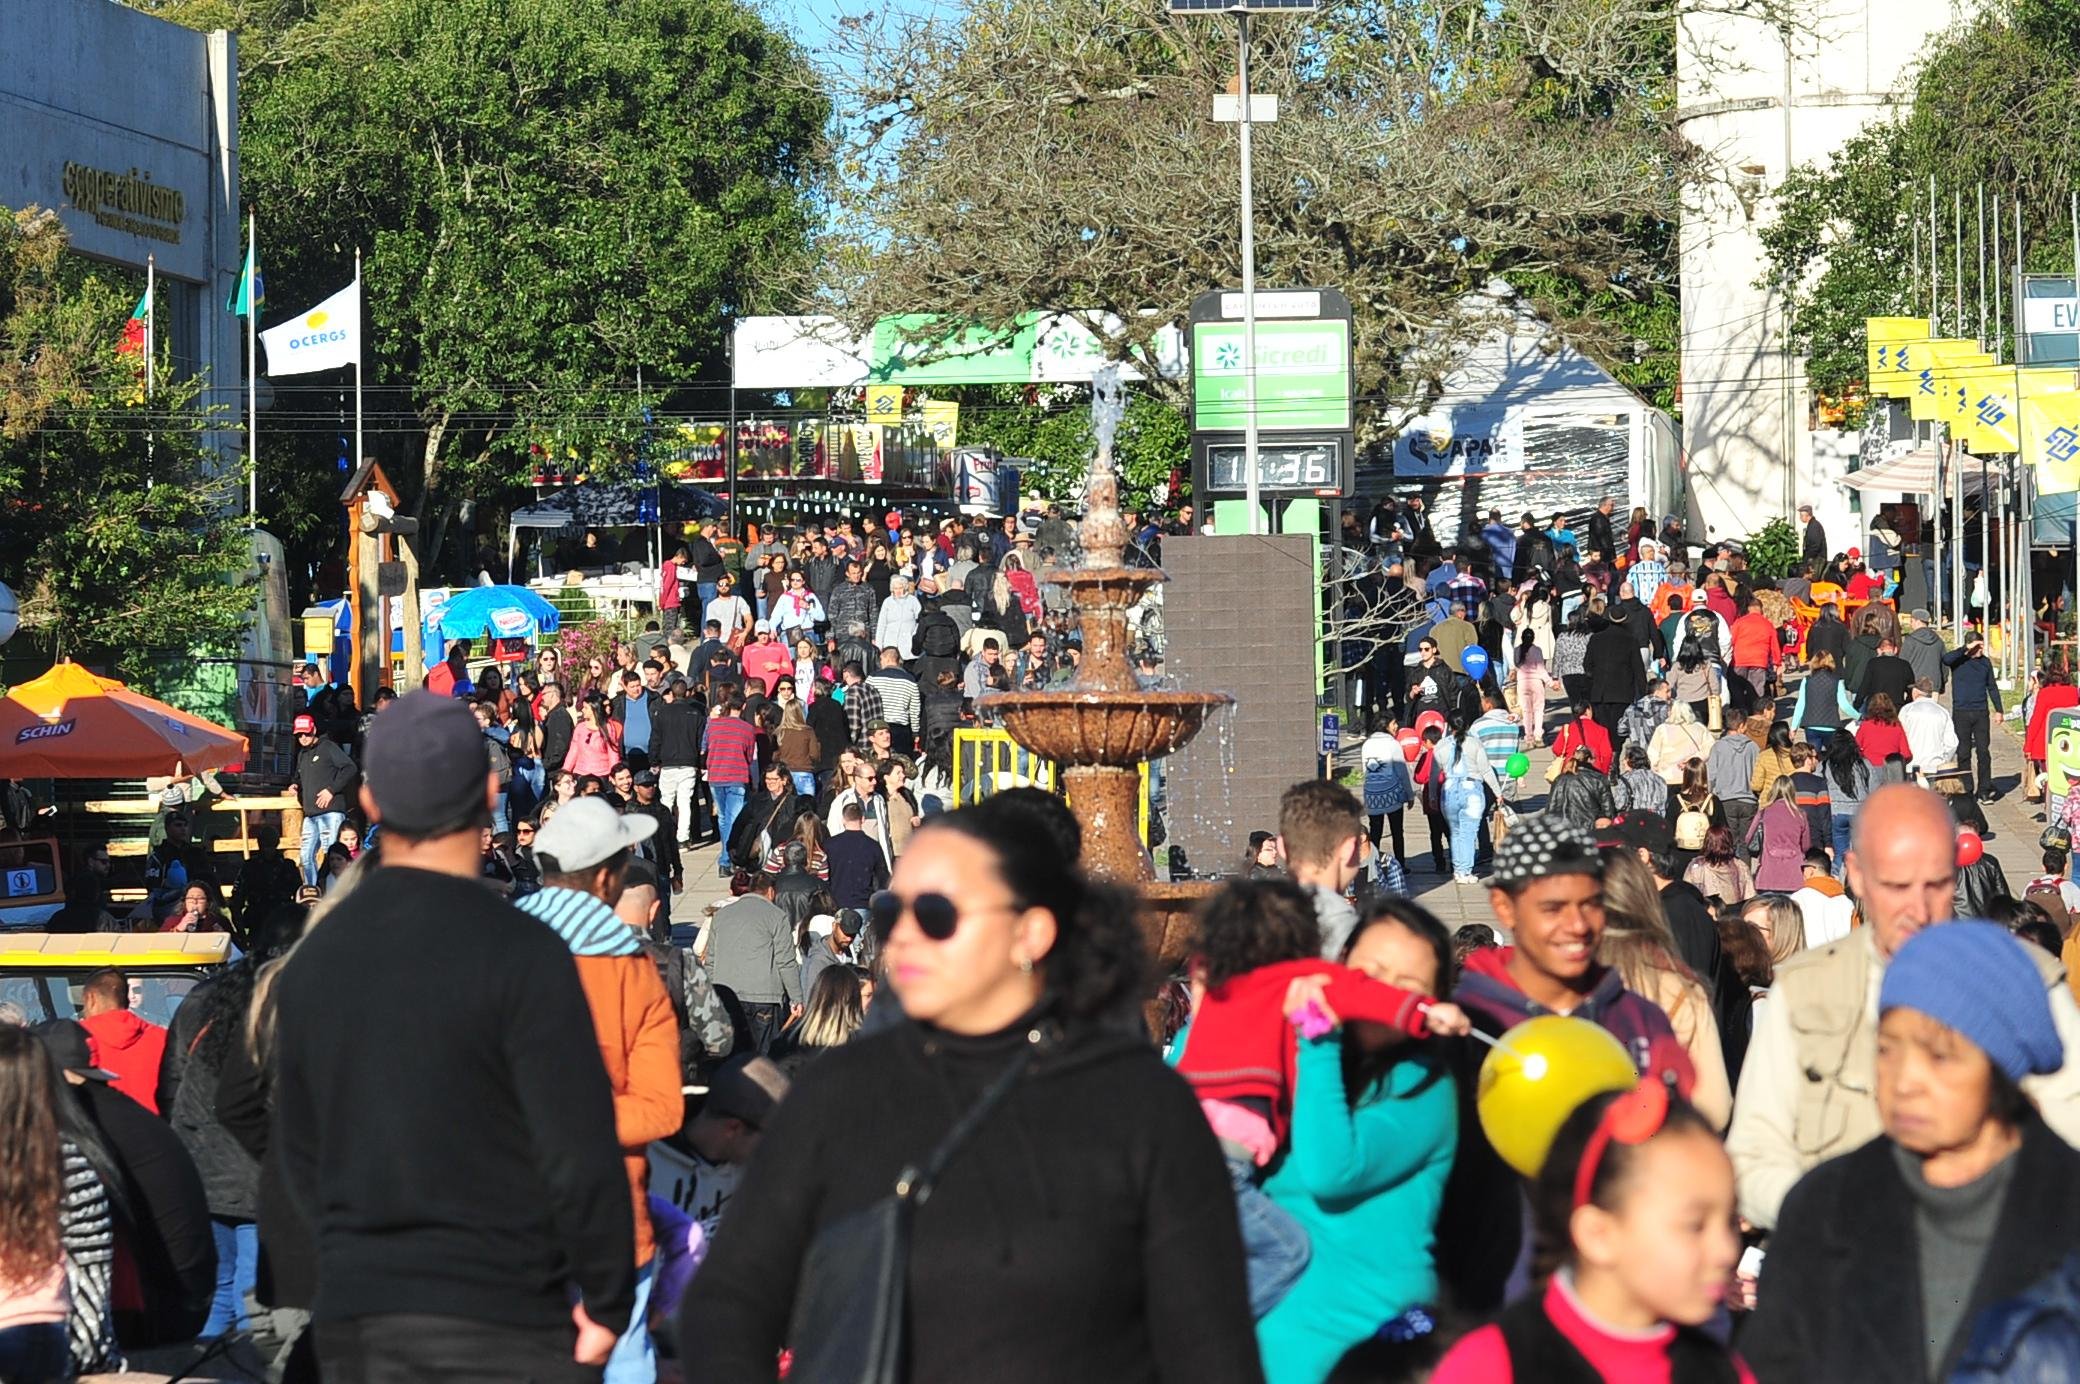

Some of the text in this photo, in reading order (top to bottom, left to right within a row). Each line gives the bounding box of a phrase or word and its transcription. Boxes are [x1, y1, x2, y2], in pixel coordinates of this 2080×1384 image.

[64, 161, 185, 225] cooperativismo
[2054, 303, 2078, 328] EV
[290, 329, 346, 349] OCERGS
[1450, 438, 1507, 457] APAE
[19, 723, 72, 740] SCHIN
